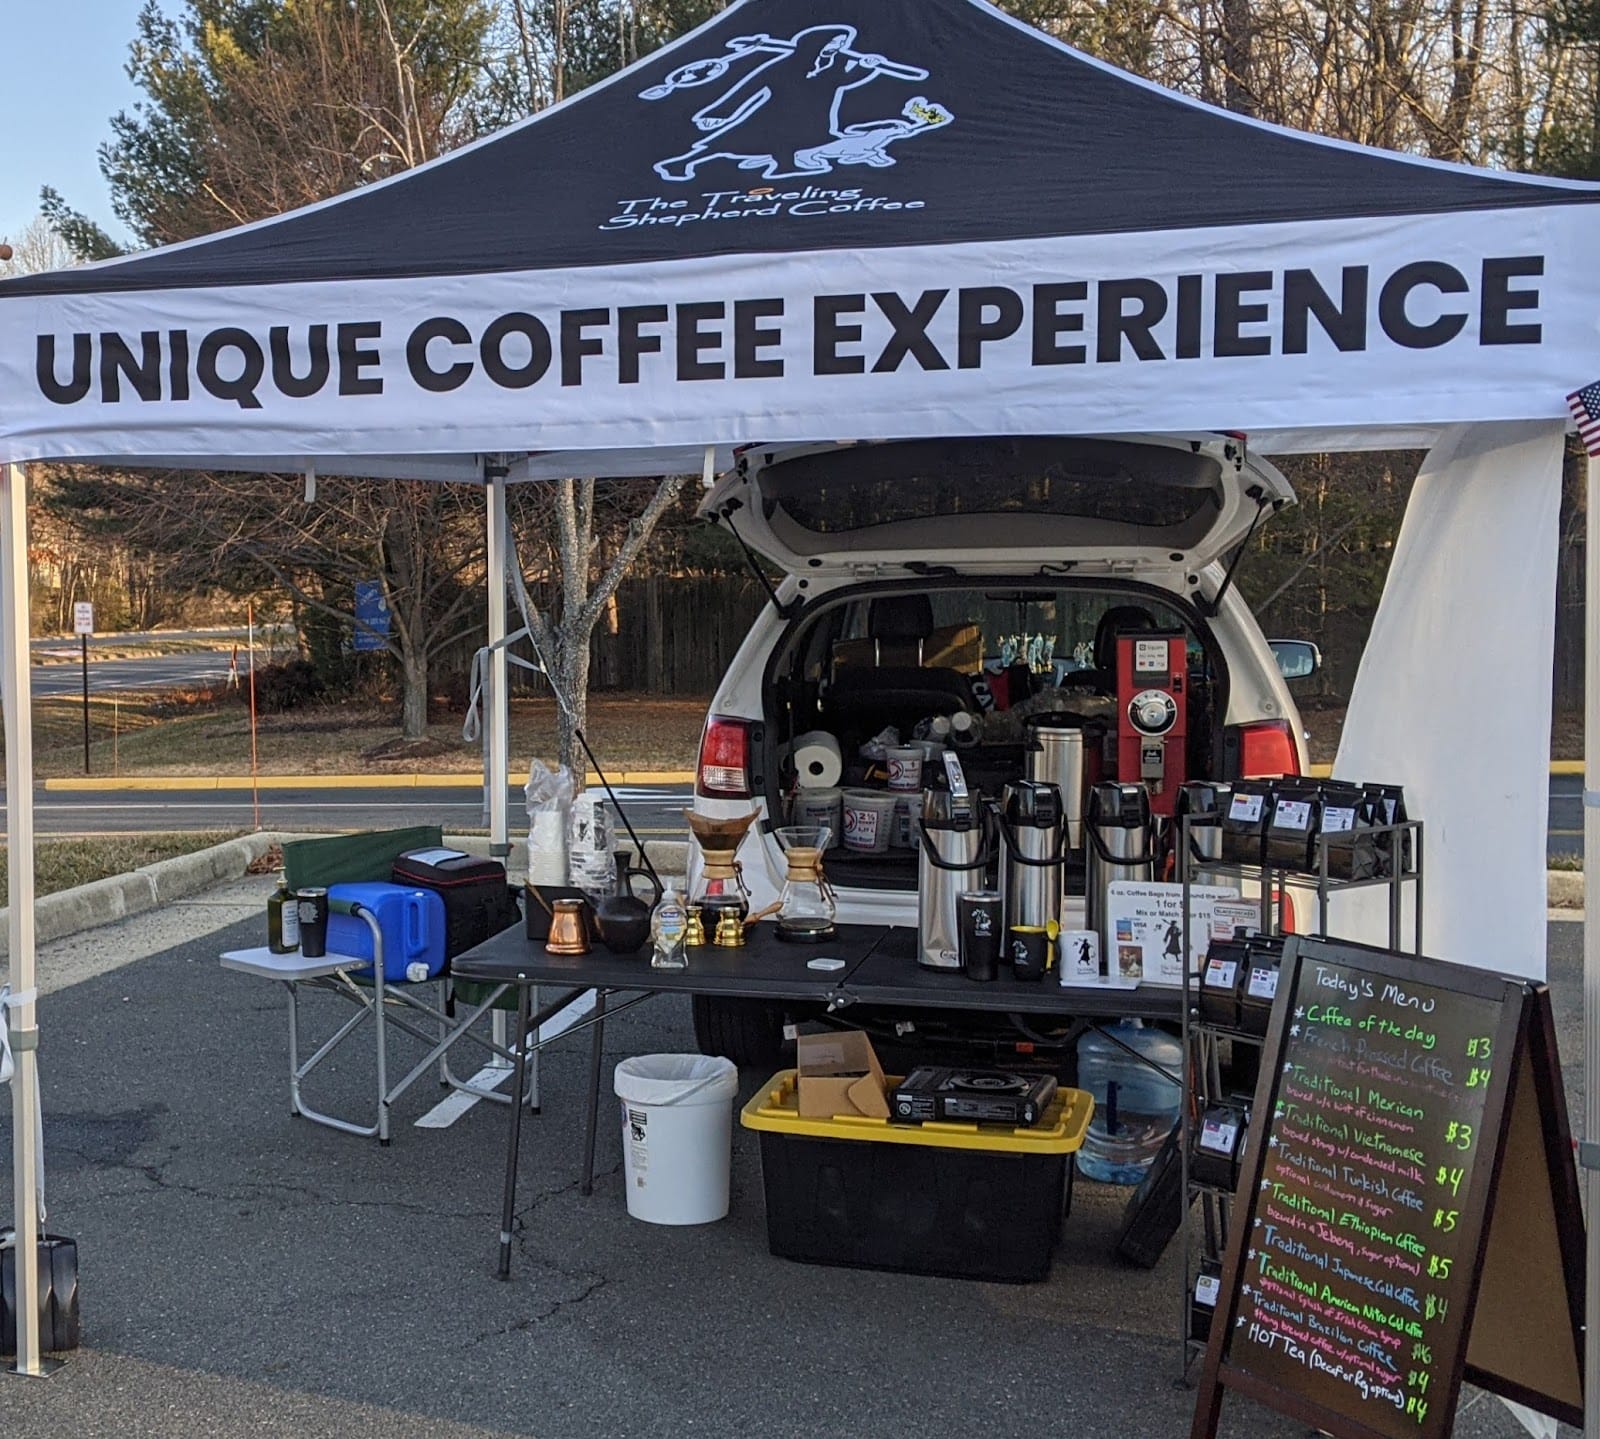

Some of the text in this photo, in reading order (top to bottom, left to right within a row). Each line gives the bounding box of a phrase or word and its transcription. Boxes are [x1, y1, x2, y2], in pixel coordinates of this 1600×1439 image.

[599, 198, 926, 229] Shepherd Coffee
[617, 186, 863, 215] The Traveling
[36, 255, 1544, 409] UNIQUE COFFEE EXPERIENCE
[1156, 900, 1160, 908] 1
[1164, 900, 1176, 908] for
[1158, 910, 1180, 918] Match
[1316, 967, 1435, 1013] Today's Menu
[1306, 1005, 1436, 1049] Coffee of the day
[1466, 1038, 1491, 1058] $3
[1411, 1055, 1454, 1086] Coffee
[1466, 1068, 1491, 1088] $4
[1292, 1065, 1360, 1103] Traditional
[1368, 1090, 1424, 1120] Mexican
[1285, 1104, 1426, 1166] Traditional Vietnamese
[1445, 1121, 1473, 1150] $3
[1279, 1142, 1424, 1212] Traditional Turkish Coffee
[1398, 1166, 1425, 1185] milk
[1436, 1167, 1464, 1197] $4
[1272, 1183, 1426, 1258] Traditional Ethiopian Coffee
[1433, 1208, 1460, 1233] $5
[1264, 1224, 1328, 1270] Traditional
[1331, 1258, 1376, 1293] Japanese
[1428, 1255, 1452, 1280] $5
[1258, 1251, 1318, 1298] Traditional
[1320, 1285, 1360, 1315] American
[1362, 1304, 1387, 1324] Nitro
[1425, 1294, 1449, 1324] $4
[1248, 1322, 1284, 1349] HOT
[1281, 1335, 1306, 1365] Tea
[1252, 1290, 1303, 1324] Traditional
[1308, 1314, 1354, 1346] Brazilian
[1357, 1339, 1398, 1372] Coffee
[1408, 1370, 1430, 1394] $4
[1406, 1396, 1428, 1422] $4
